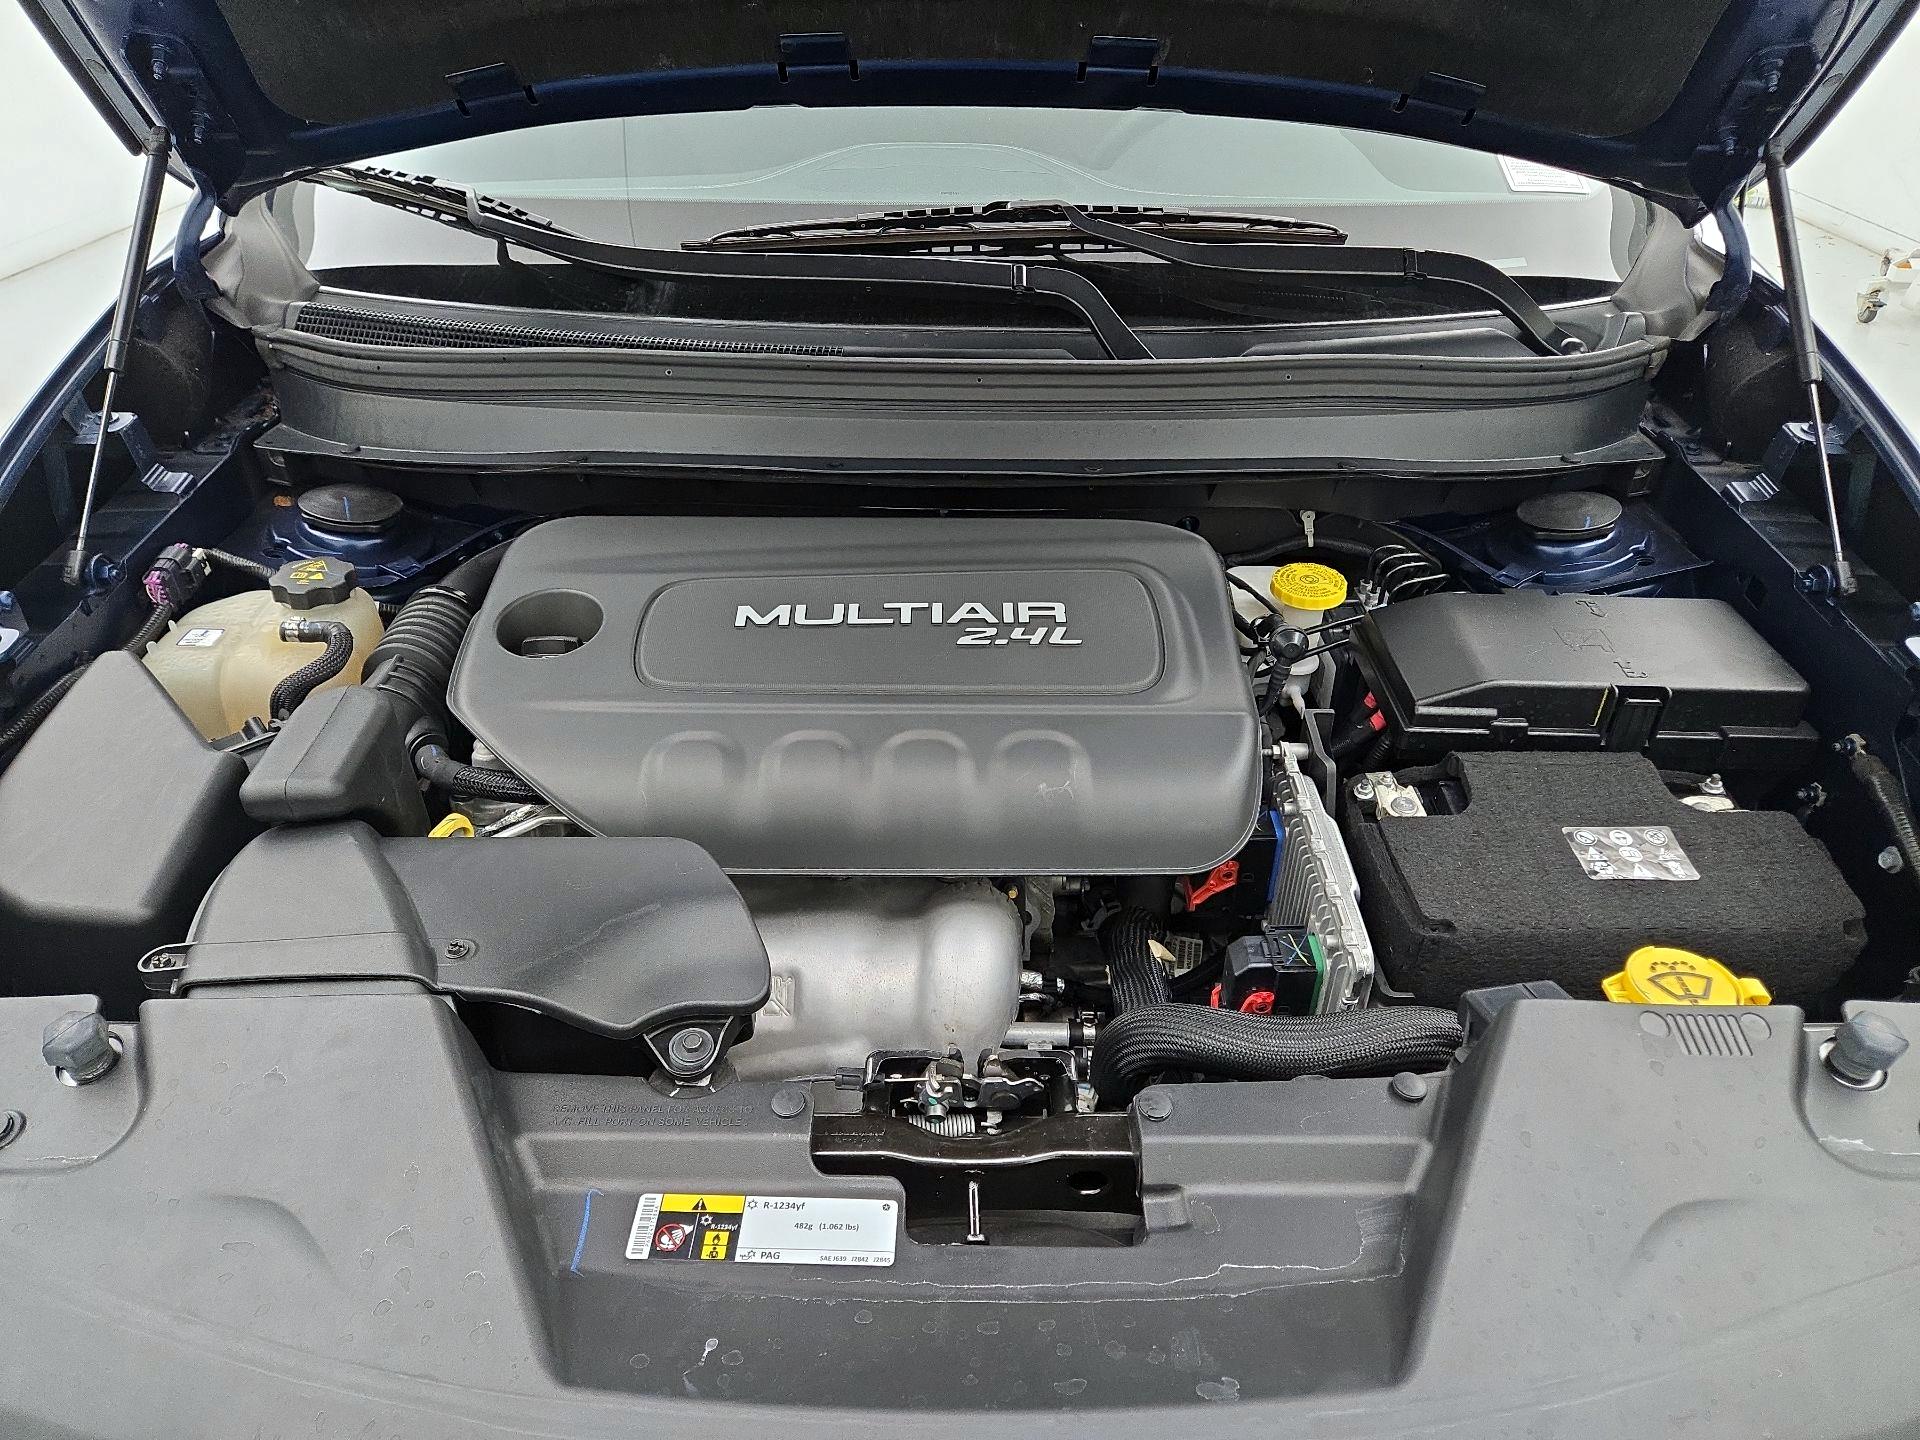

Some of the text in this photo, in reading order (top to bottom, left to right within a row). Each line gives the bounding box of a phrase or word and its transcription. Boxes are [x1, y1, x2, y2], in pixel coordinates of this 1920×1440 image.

[734, 602, 1067, 627] MULTIAIR
[955, 627, 1083, 646] 2.4L
[629, 1105, 664, 1114] PANEL
[577, 1117, 599, 1127] FILL
[605, 1117, 634, 1127] PORT
[638, 1117, 656, 1127] ON
[658, 1117, 691, 1127] SOME
[763, 1201, 806, 1211] R-1234yf
[794, 1222, 859, 1232] 482g (1.062 lbs)
[760, 1251, 780, 1260] PAG
